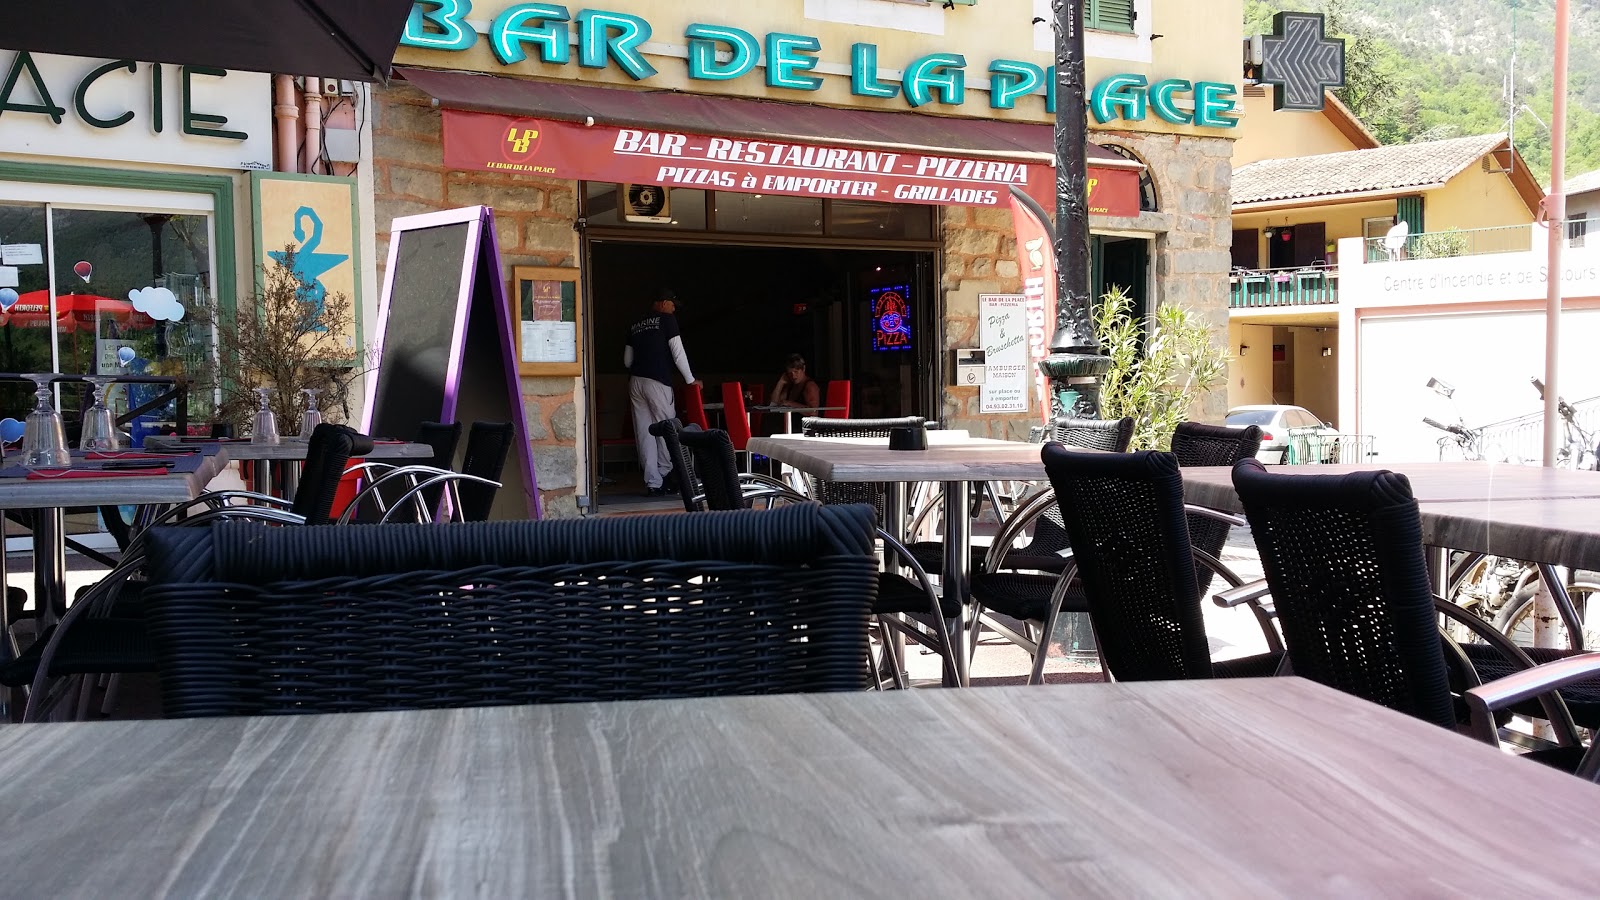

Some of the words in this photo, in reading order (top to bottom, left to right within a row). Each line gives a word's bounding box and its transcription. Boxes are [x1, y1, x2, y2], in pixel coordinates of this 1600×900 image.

[400, 0, 659, 81] BAR
[685, 23, 823, 91] DE
[852, 43, 967, 107] LA
[614, 130, 686, 155] BAR
[706, 138, 901, 172] RESTAURANT
[916, 157, 1028, 183] PIZZERIA
[533, 166, 557, 174] PLACE
[656, 166, 737, 188] PIZZAS
[741, 172, 757, 189] à
[762, 175, 877, 197] EMPORTER
[894, 184, 998, 205] GRILLADES
[1384, 276, 1424, 292] Centre
[1500, 271, 1511, 284] et
[1517, 269, 1532, 284] de
[1539, 266, 1596, 283] Sours
[987, 313, 1010, 328] Pizza
[877, 330, 908, 346] PIZZA
[999, 327, 1006, 339] &
[986, 335, 1025, 357] Bruschetta
